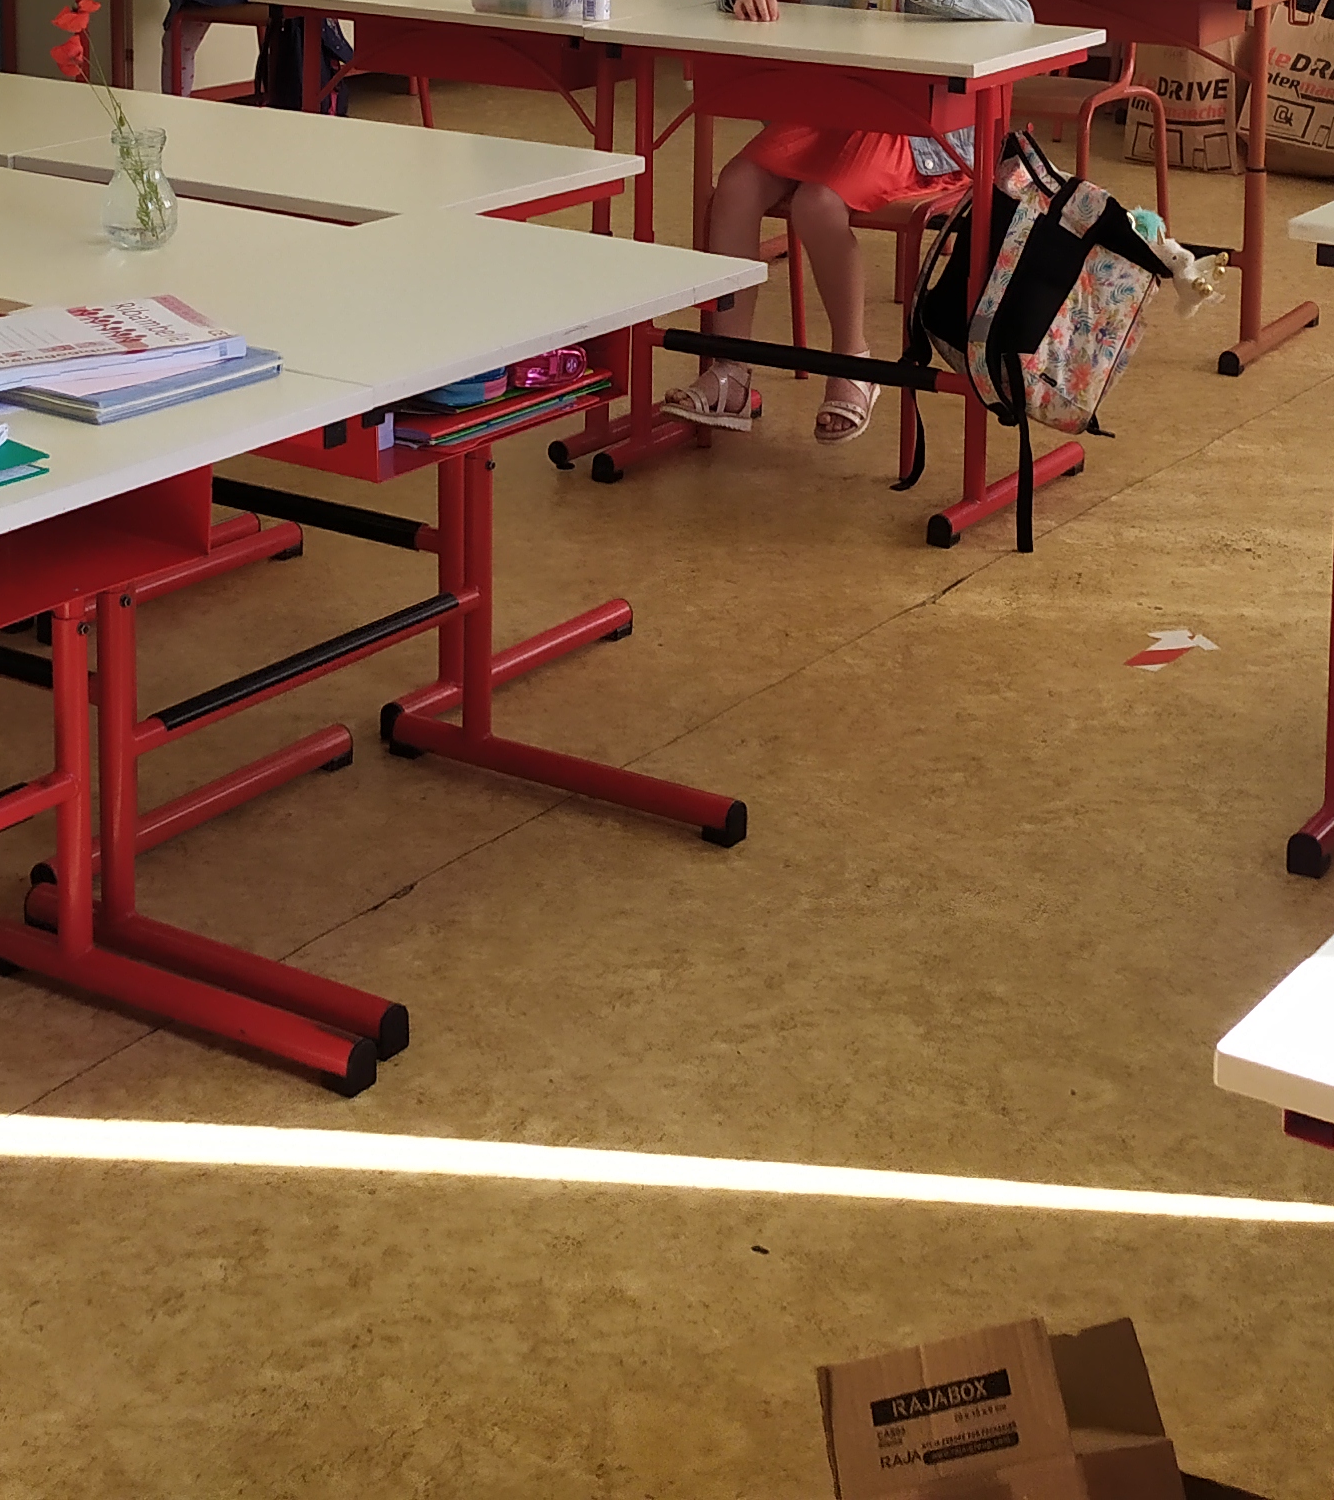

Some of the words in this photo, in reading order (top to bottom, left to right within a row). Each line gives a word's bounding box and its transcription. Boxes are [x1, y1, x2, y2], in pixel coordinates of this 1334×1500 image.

[114, 301, 191, 345] Ribambelle
[891, 1379, 989, 1418] RAJABOX
[880, 1450, 922, 1469] RAJA
